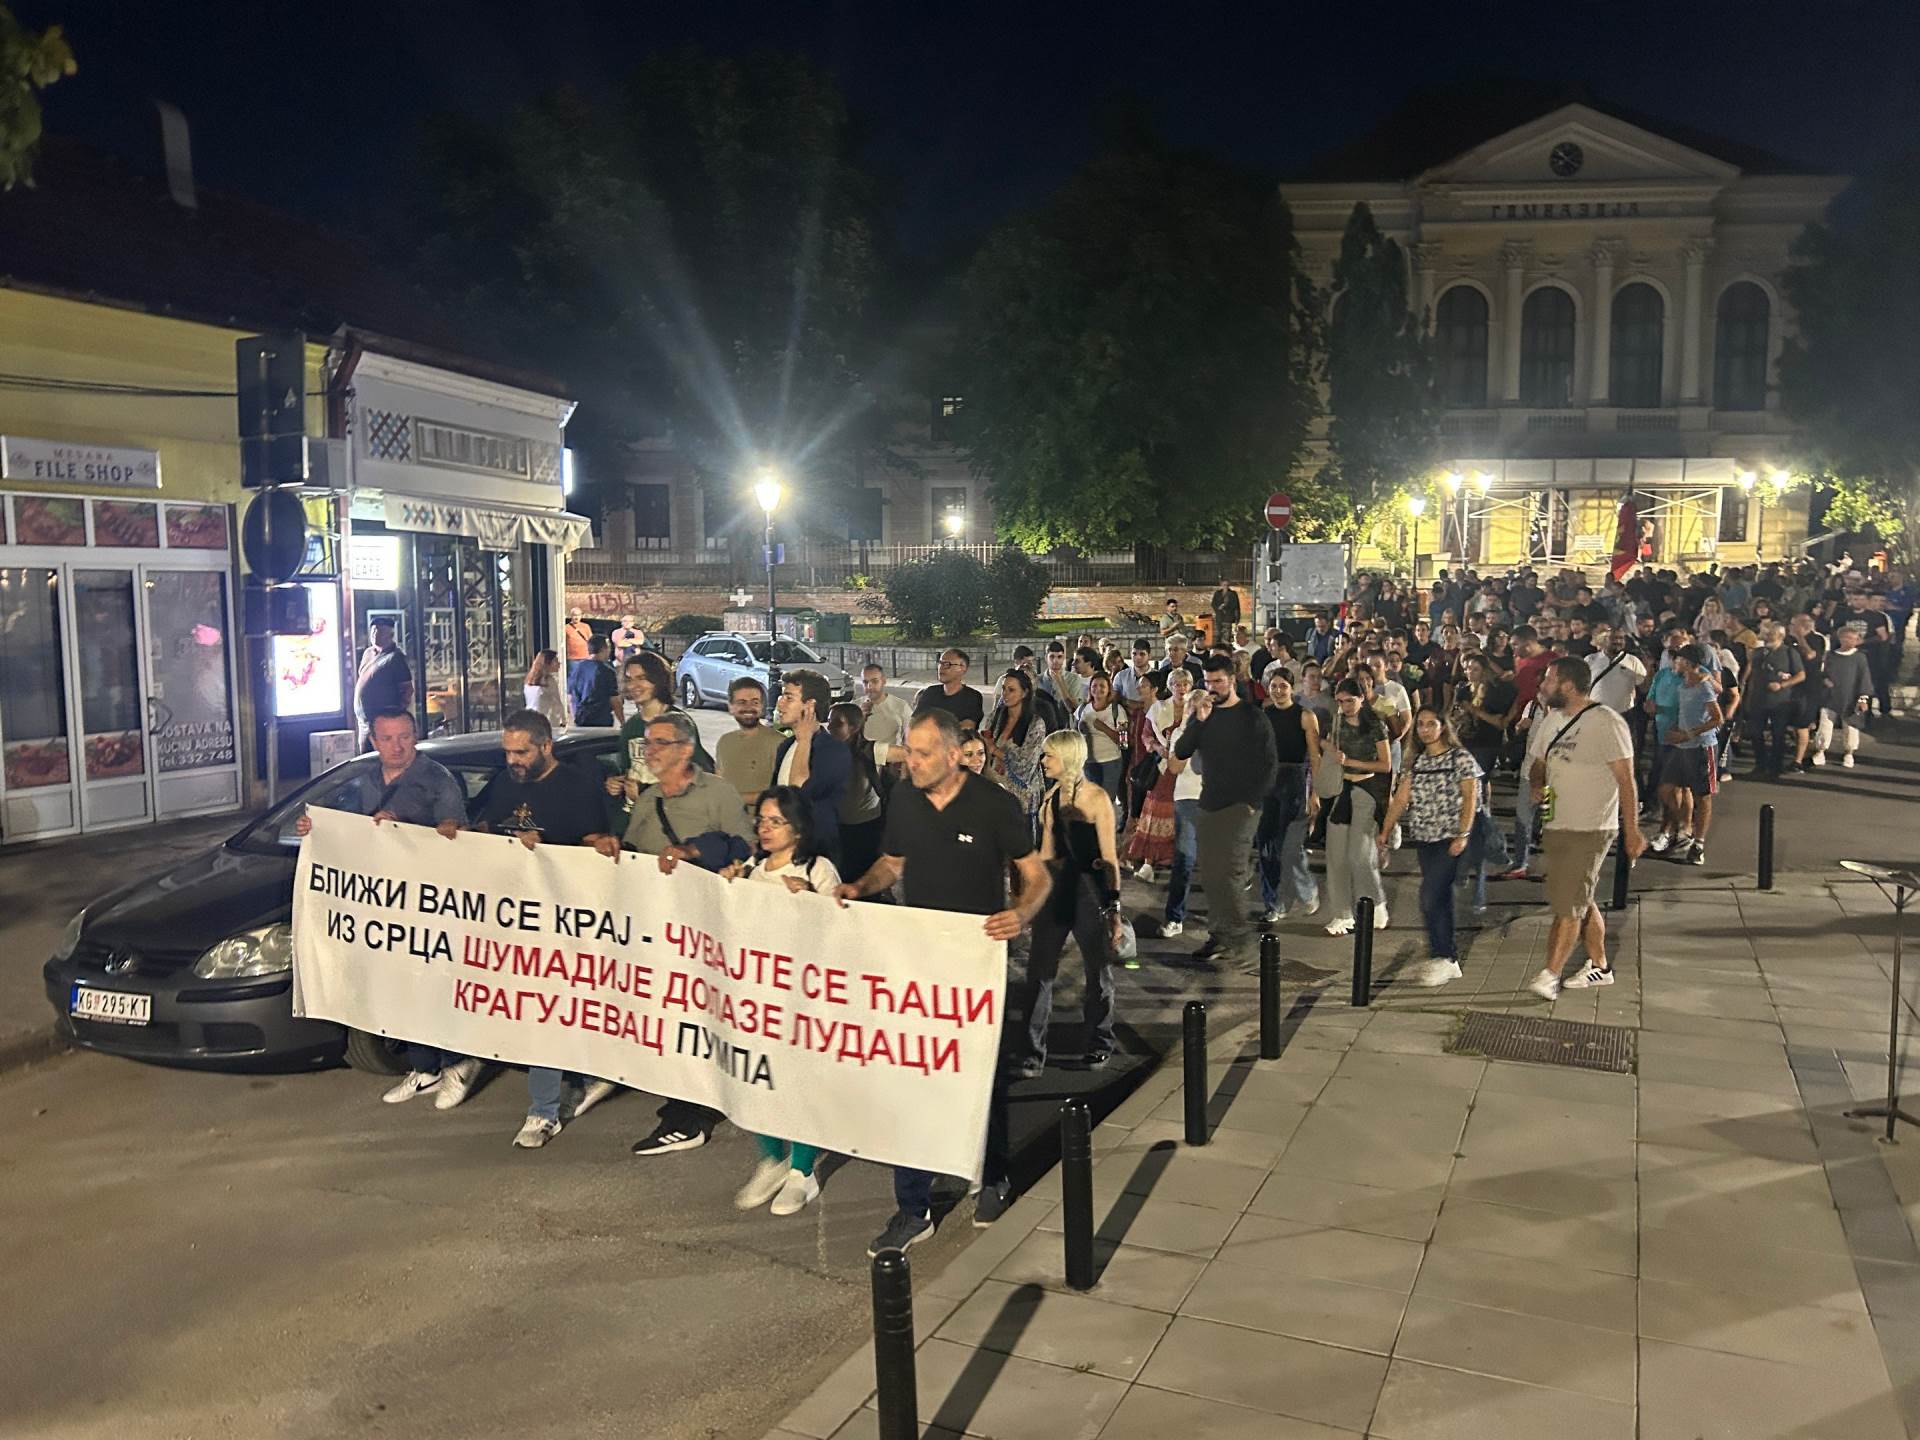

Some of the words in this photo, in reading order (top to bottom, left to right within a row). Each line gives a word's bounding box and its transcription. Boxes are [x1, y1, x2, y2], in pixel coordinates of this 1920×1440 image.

[34, 460, 77, 479] FILE
[85, 463, 134, 482] SHOP
[215, 719, 232, 733] NA
[195, 735, 233, 750] ADRESU
[309, 862, 407, 911] БЛИЖИ
[418, 883, 486, 923] ВАМ
[496, 897, 541, 931] СЕ
[555, 904, 631, 946] КРАЈ
[665, 922, 793, 991] ЧУВАЈТЕ
[801, 963, 849, 1004] СЕ
[861, 973, 994, 1029] ЋАЦИ
[79, 991, 92, 1011] KG
[327, 908, 356, 944] ИЗ
[364, 920, 453, 963] СРЦА
[462, 935, 653, 999] ШУМАДИЈЕ
[662, 971, 783, 1040] ДОЛАЗЕ
[789, 1013, 960, 1076] ЛУДАЦИ
[454, 978, 664, 1056] КРАГУЈЕВАЦ
[676, 1021, 775, 1091] ПУМПА
